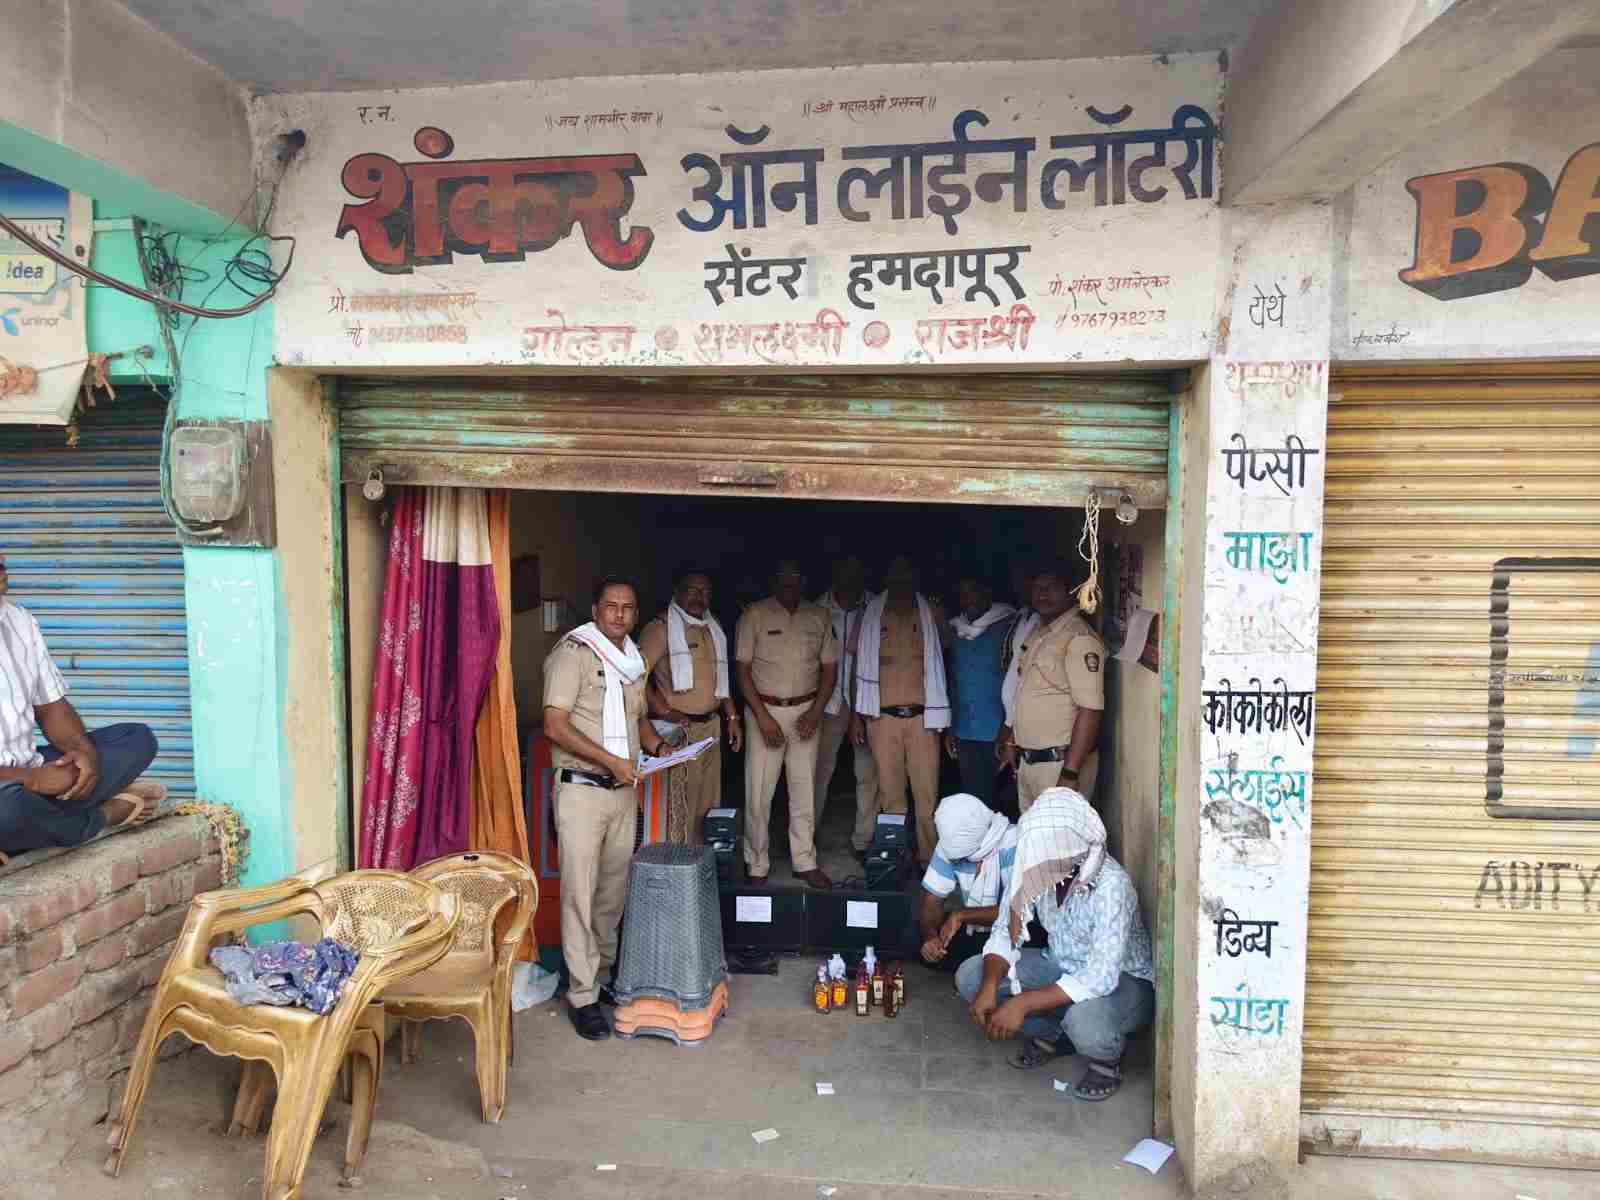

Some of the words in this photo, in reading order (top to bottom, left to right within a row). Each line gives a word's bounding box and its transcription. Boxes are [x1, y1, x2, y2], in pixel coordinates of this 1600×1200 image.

[336, 126, 655, 275] शंकर
[676, 123, 824, 233] ऑन
[836, 109, 1036, 236] लाईन
[1039, 103, 1218, 211] लॉटरी
[703, 243, 806, 306] सेंटर
[846, 245, 1032, 310] हमदापूर
[1221, 432, 1319, 496] पेप्सी
[1223, 531, 1313, 584] माझा
[1202, 677, 1313, 746] कोकोकोला
[1474, 860, 1600, 912] ADITY
